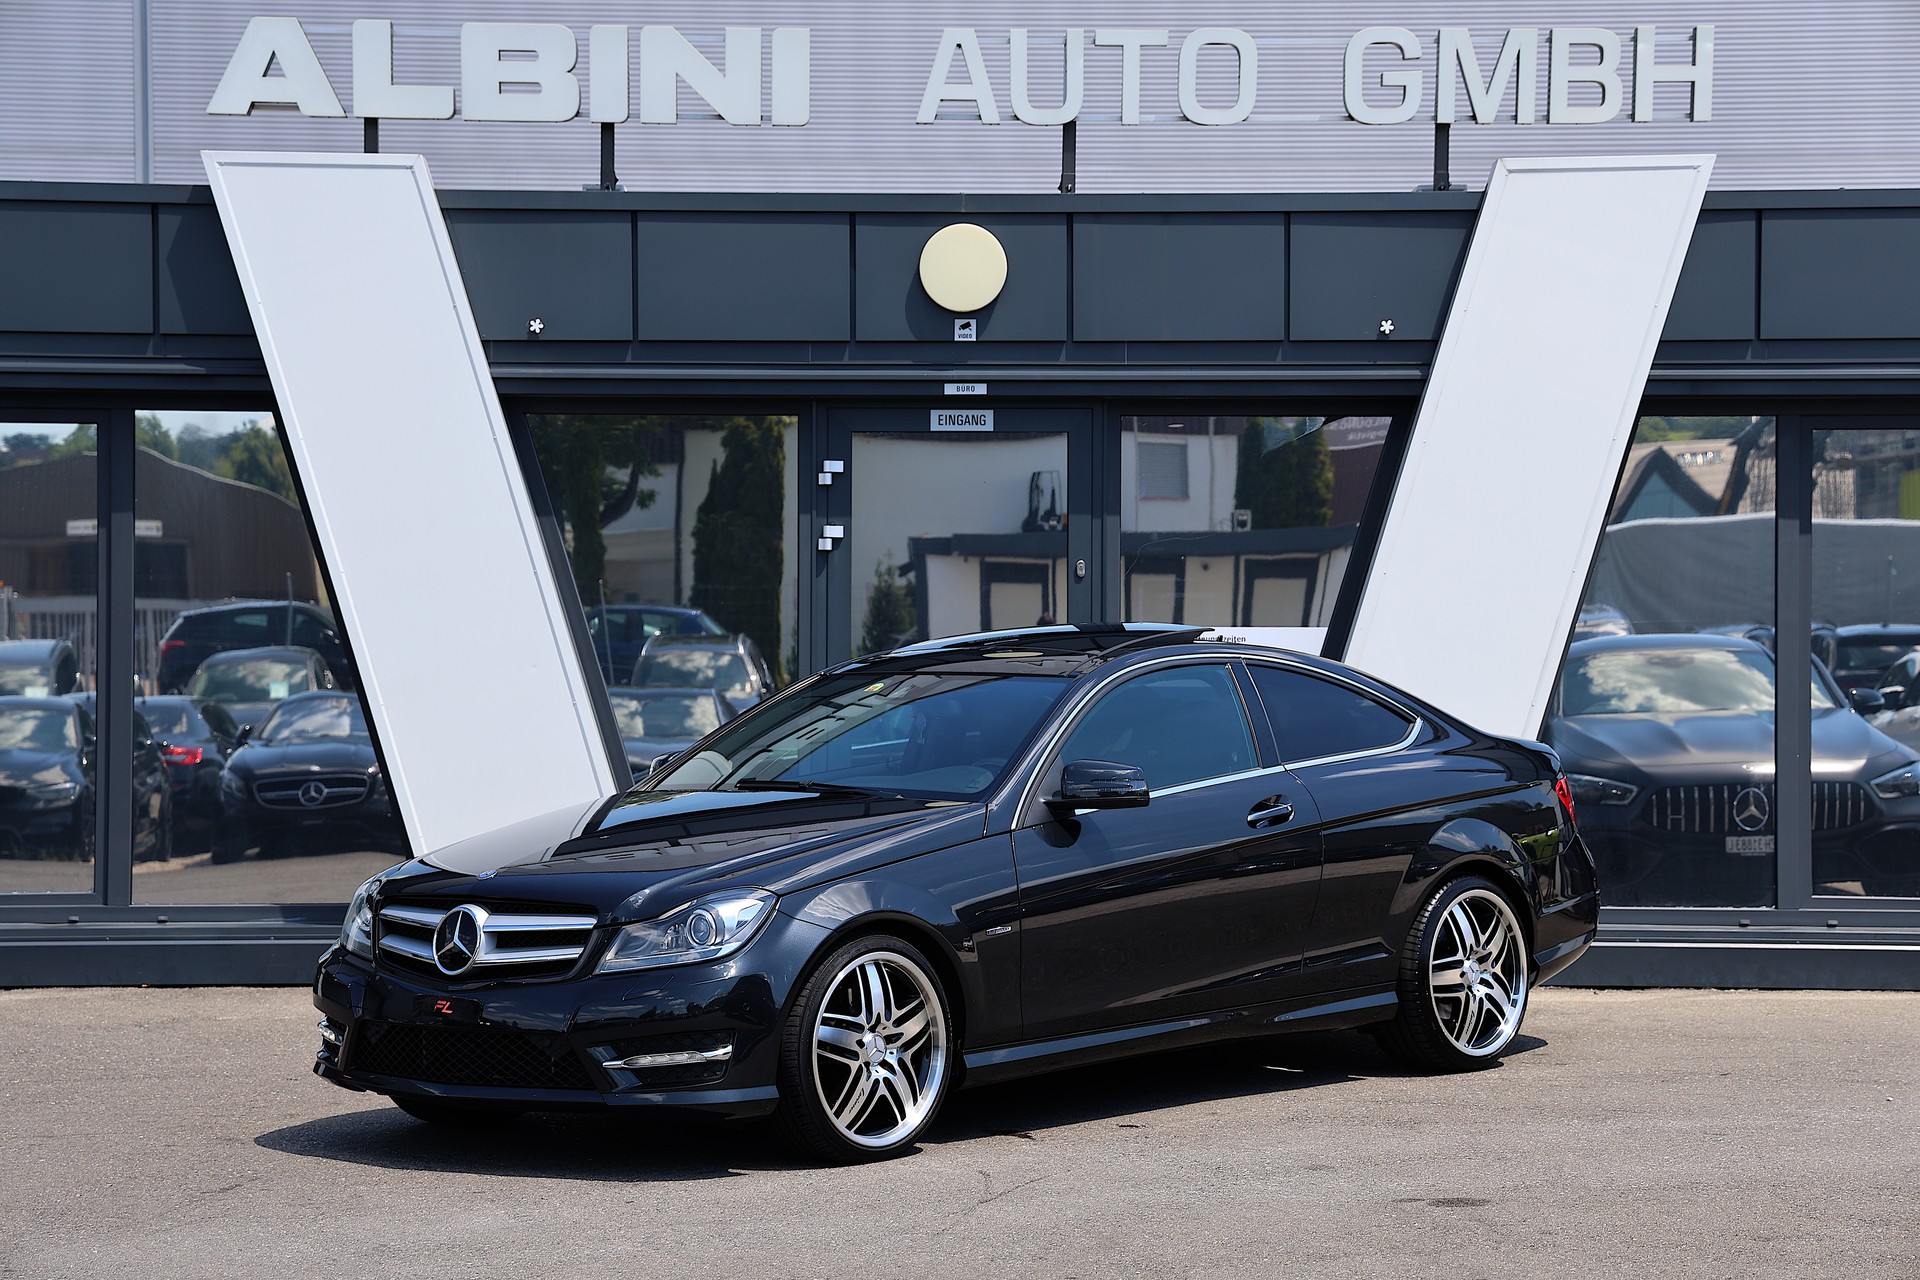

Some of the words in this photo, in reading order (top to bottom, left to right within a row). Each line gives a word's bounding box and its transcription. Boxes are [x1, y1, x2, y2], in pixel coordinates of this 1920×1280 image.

[206, 16, 810, 126] ALBINI
[916, 27, 1258, 125] AUTO
[1343, 25, 1715, 125] GMBH
[938, 414, 987, 426] EINGANG
[433, 1000, 454, 1014] FL
